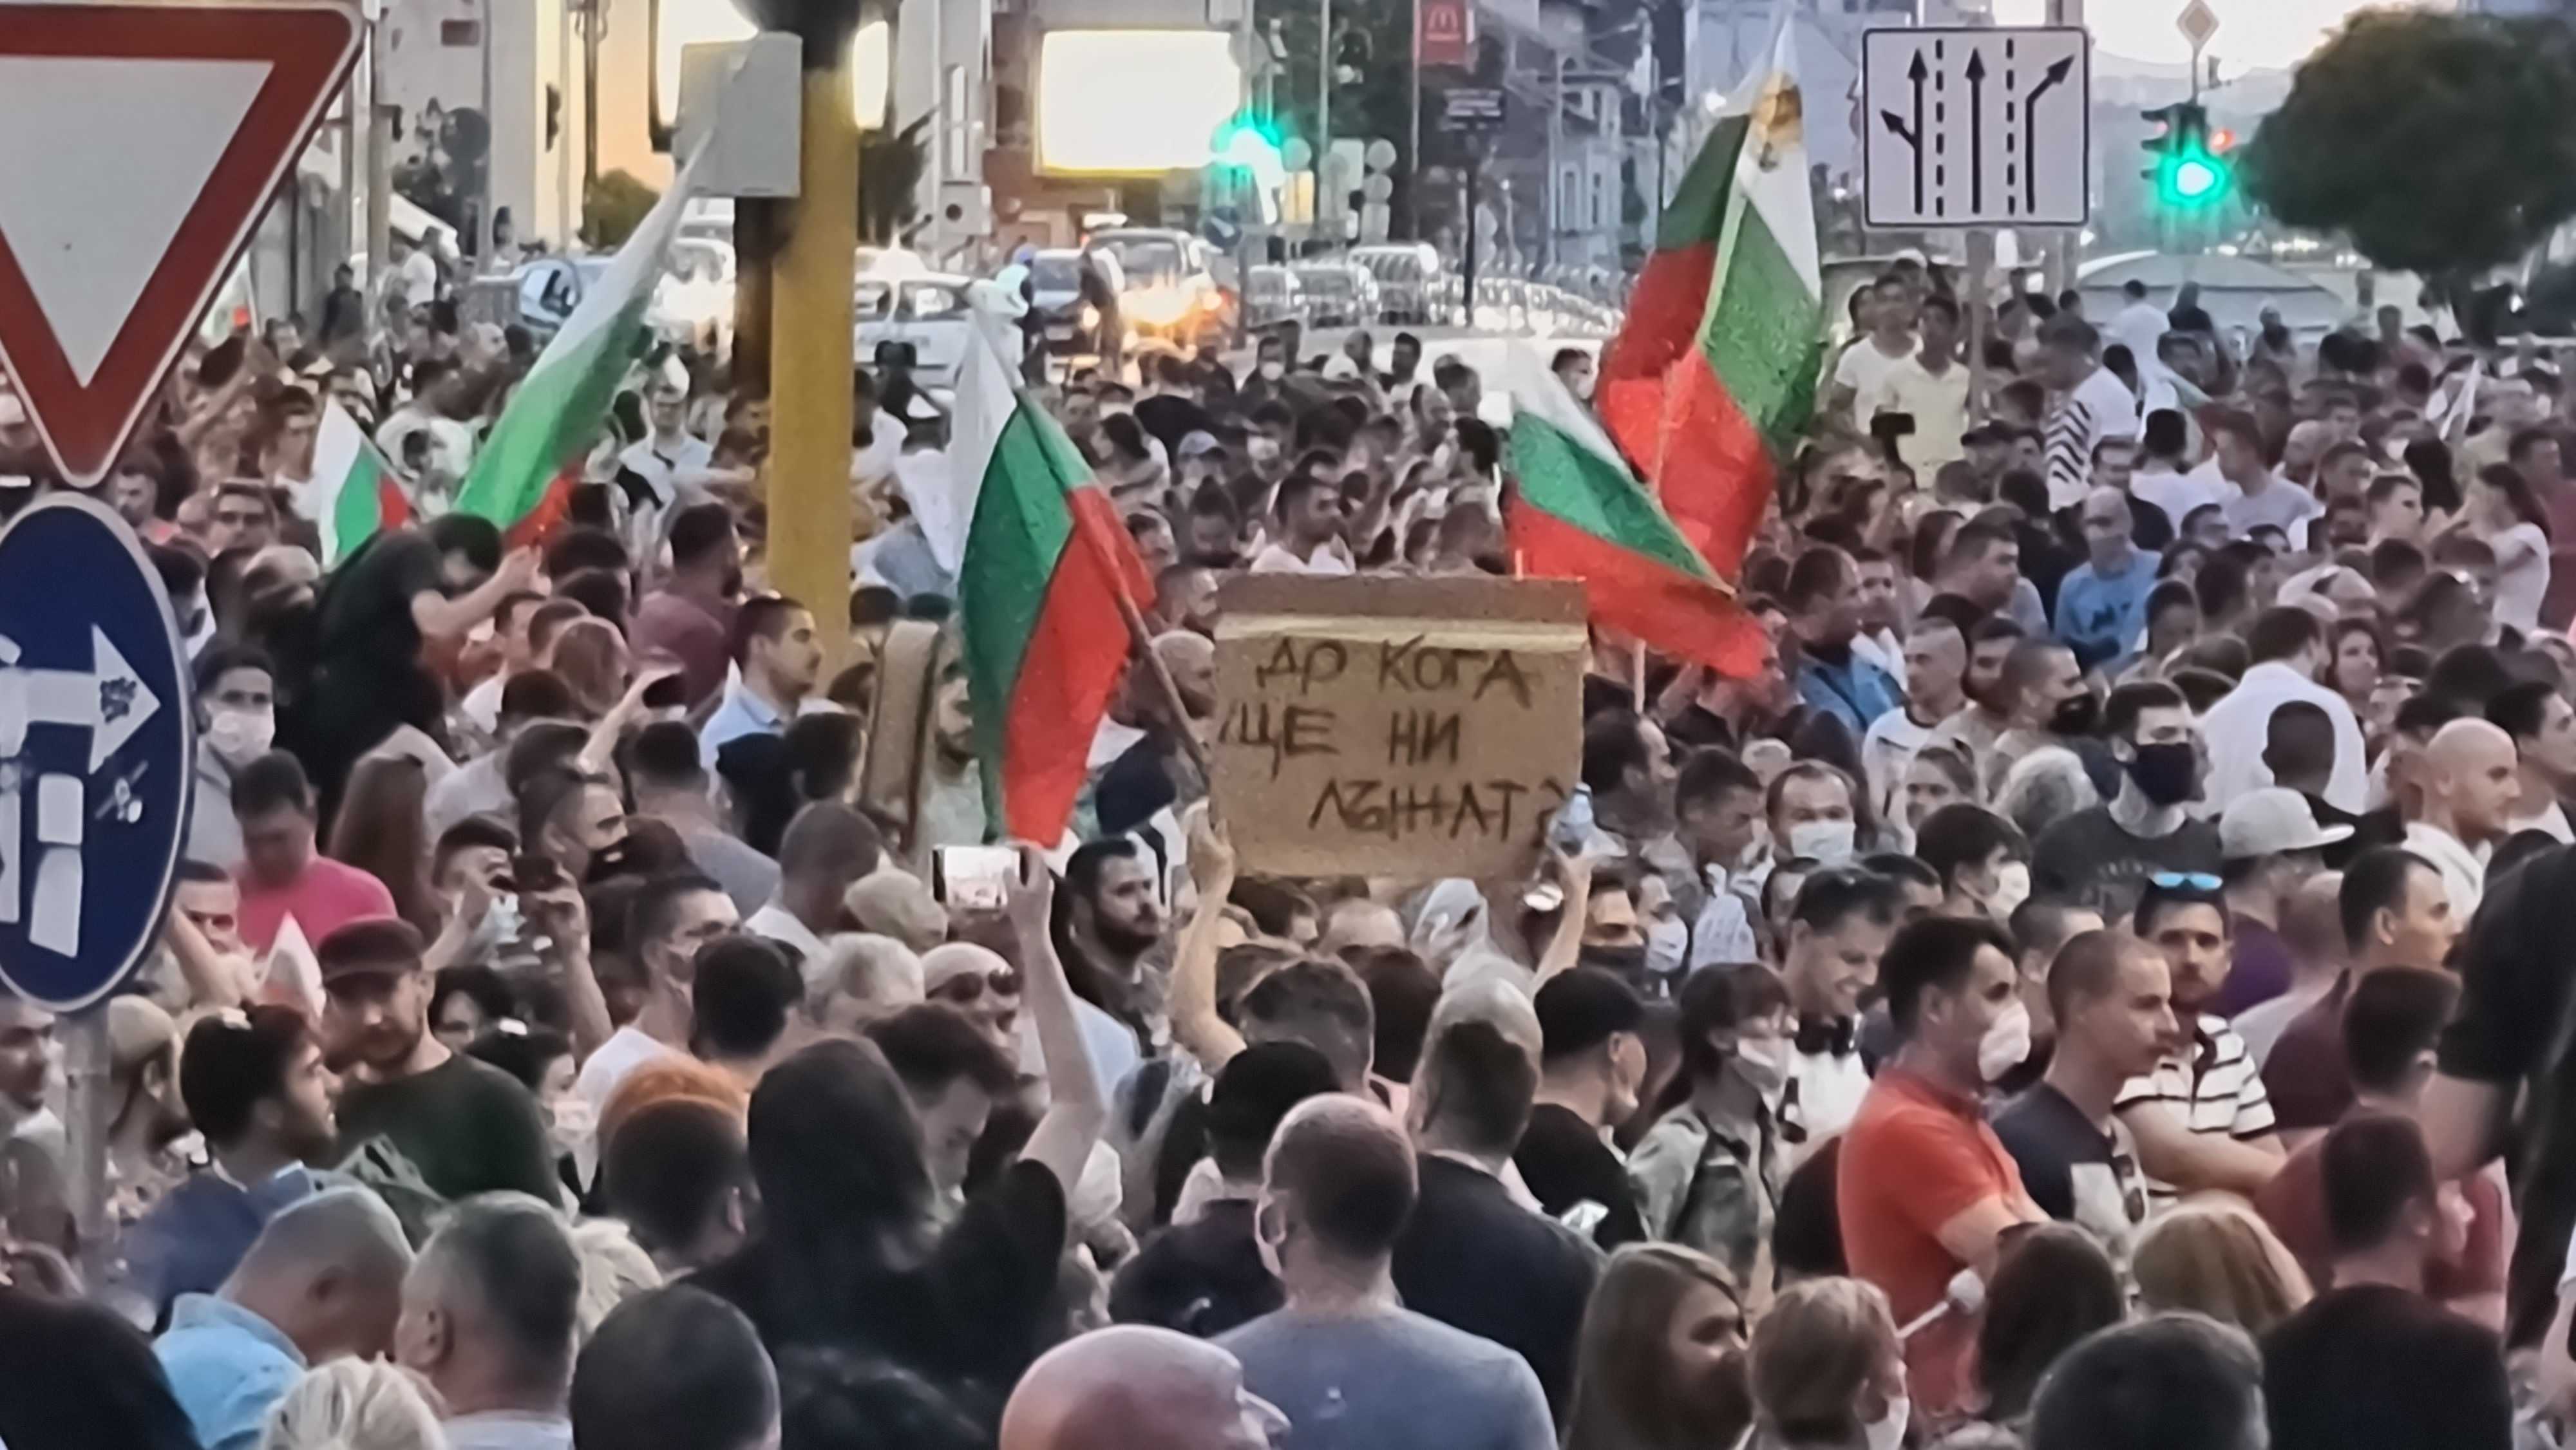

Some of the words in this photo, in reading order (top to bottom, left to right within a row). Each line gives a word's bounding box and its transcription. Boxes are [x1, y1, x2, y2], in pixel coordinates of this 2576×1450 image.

[1378, 634, 1533, 709] КОГА
[1218, 699, 1341, 782] ЩЕ
[1387, 707, 1461, 766] НИ
